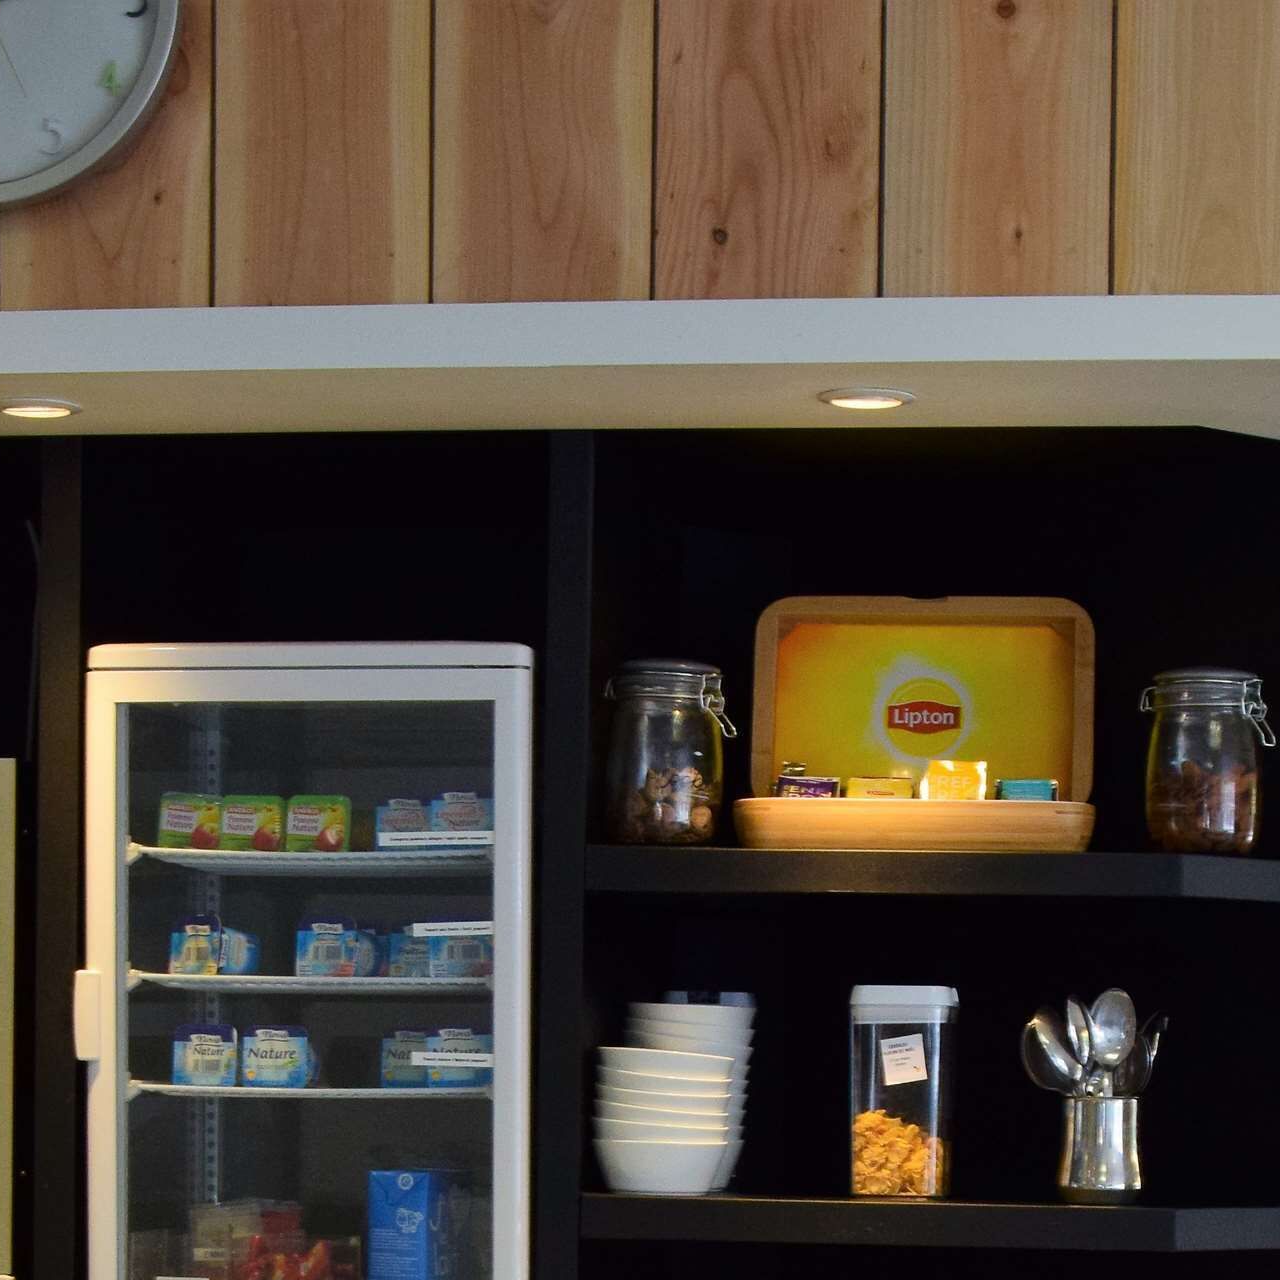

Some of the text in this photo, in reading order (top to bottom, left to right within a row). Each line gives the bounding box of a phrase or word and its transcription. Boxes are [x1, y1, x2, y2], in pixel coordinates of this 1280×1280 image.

[98, 60, 120, 97] 4
[41, 117, 67, 156] 5
[892, 706, 956, 728] Lipton
[192, 1046, 225, 1056] Nature
[247, 1046, 297, 1060] Nature
